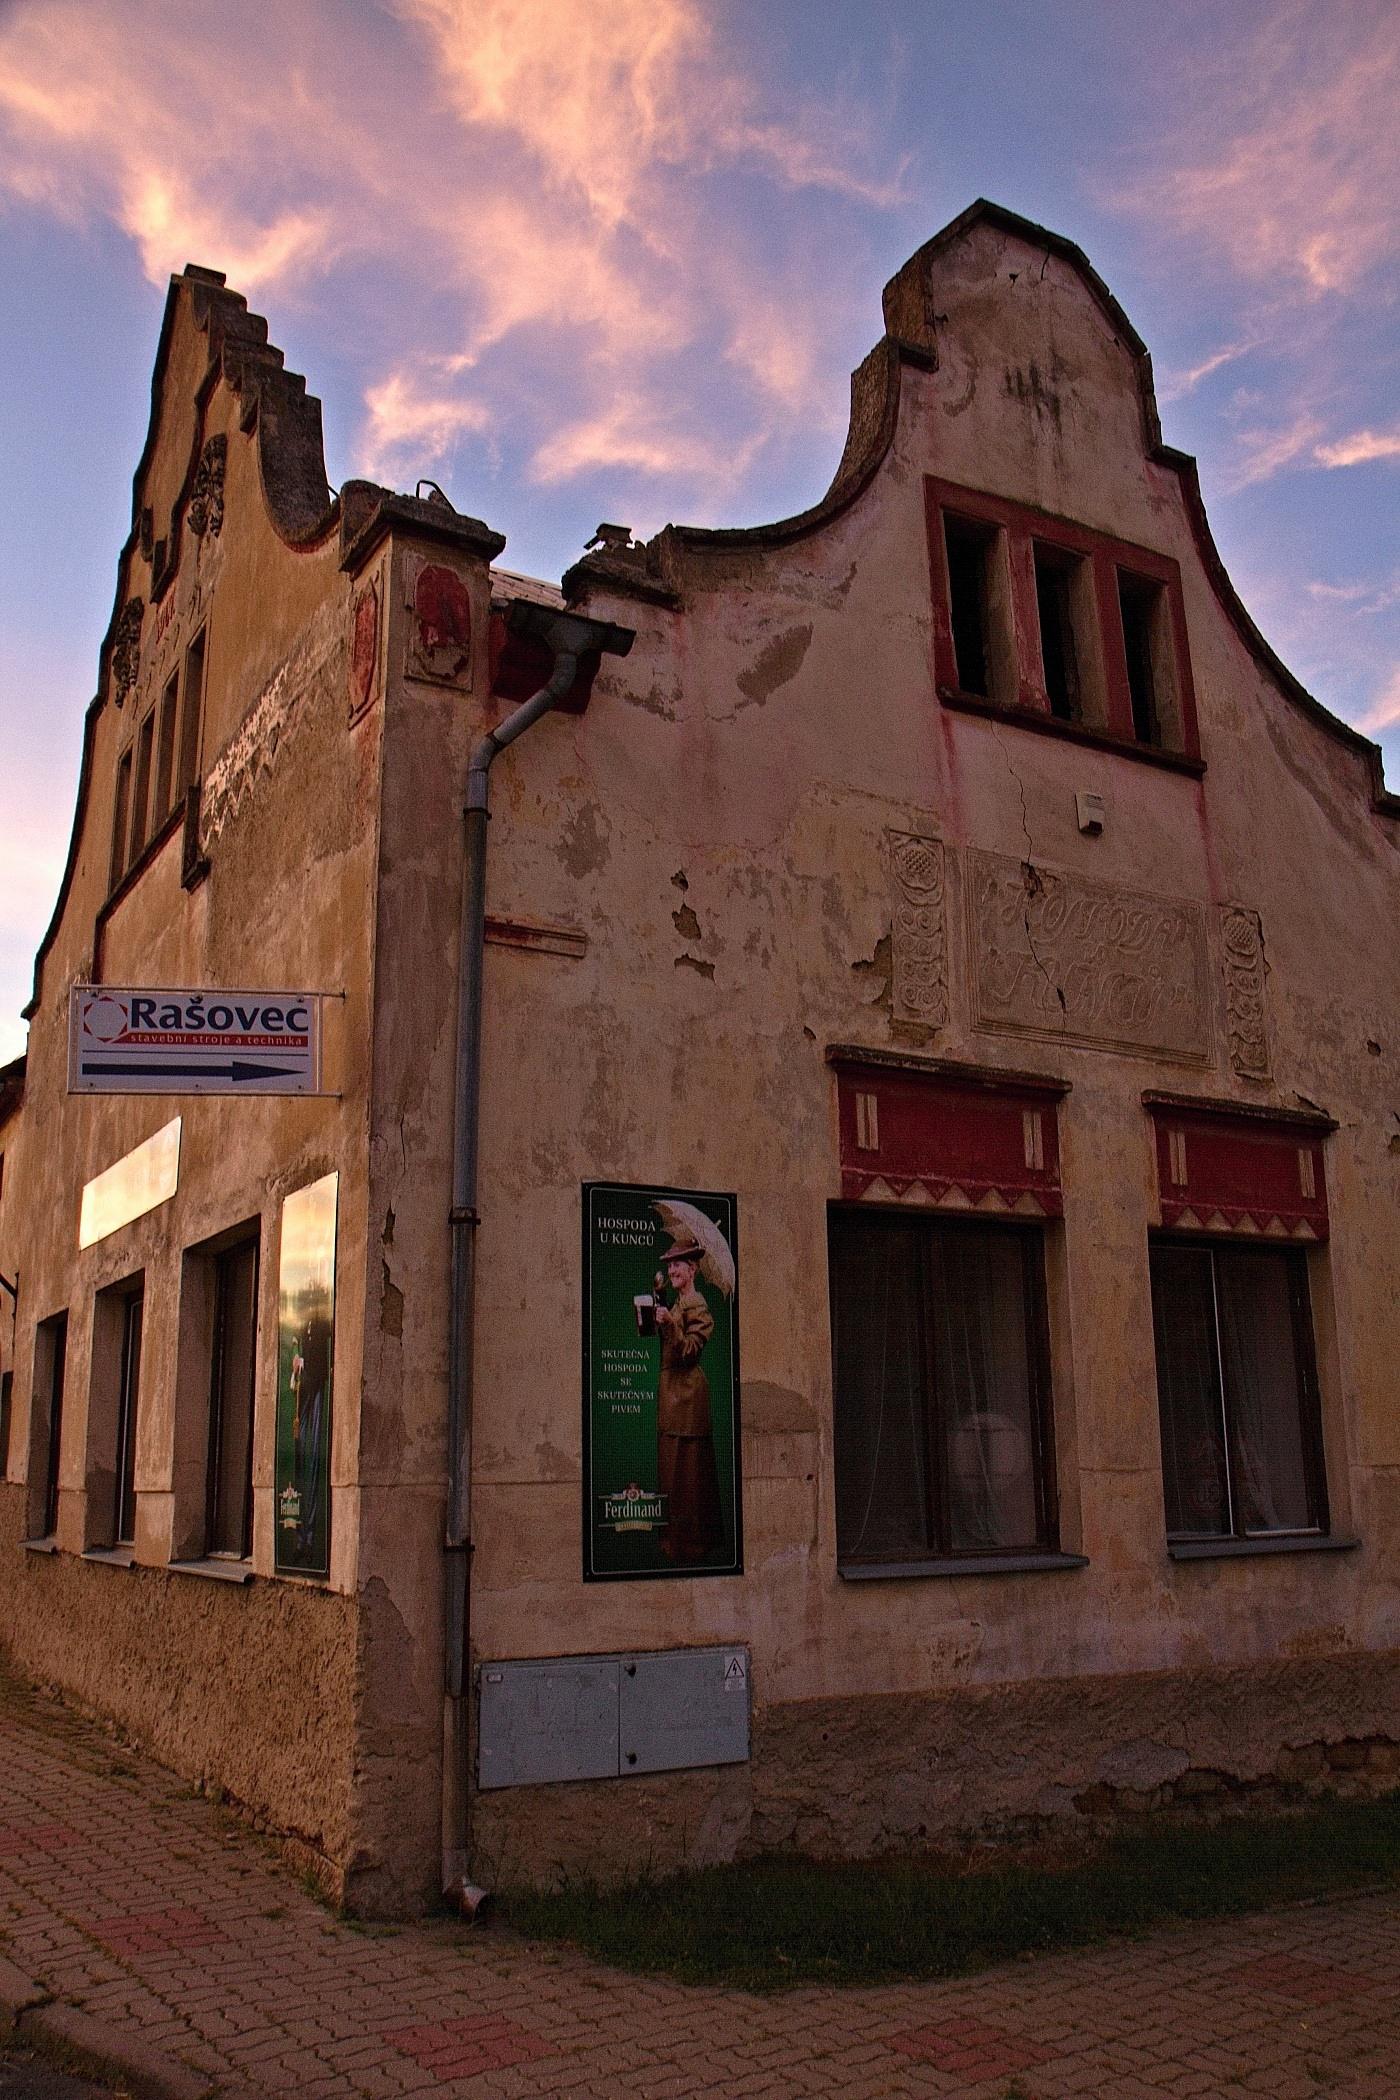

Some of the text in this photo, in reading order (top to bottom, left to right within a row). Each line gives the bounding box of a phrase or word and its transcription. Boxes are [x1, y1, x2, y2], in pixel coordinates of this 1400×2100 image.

[131, 997, 308, 1032] Rašovec
[130, 1034, 302, 1046] stavební stroje a technika
[598, 1216, 656, 1232] HOSPODA
[600, 1232, 608, 1243] U
[604, 1363, 648, 1373] HOSPODA
[620, 1376, 632, 1387] SE
[611, 1404, 641, 1414] PIVEM
[605, 1499, 662, 1519] Ferdinand
